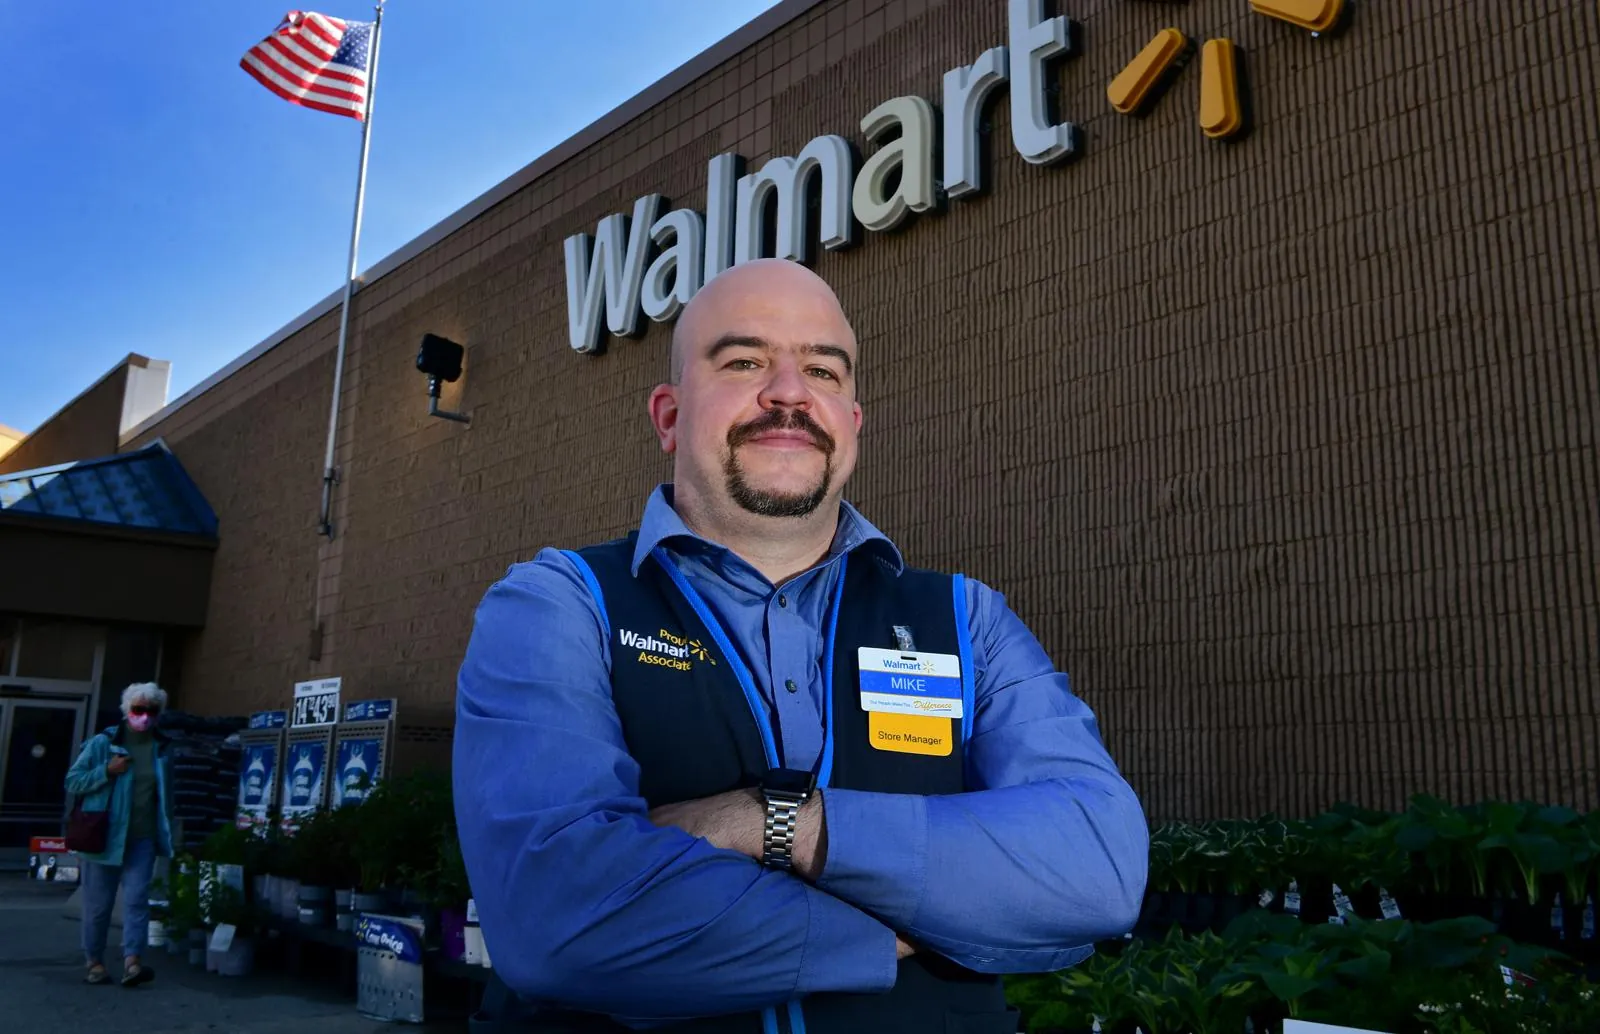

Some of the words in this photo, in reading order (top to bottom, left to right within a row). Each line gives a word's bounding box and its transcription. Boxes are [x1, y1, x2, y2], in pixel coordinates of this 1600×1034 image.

[563, 0, 1074, 354] Walmart
[883, 659, 921, 671] Walmart
[891, 676, 927, 692] MIKE
[913, 700, 953, 712] Difference
[878, 730, 901, 742] Store
[903, 733, 943, 746] Manager
